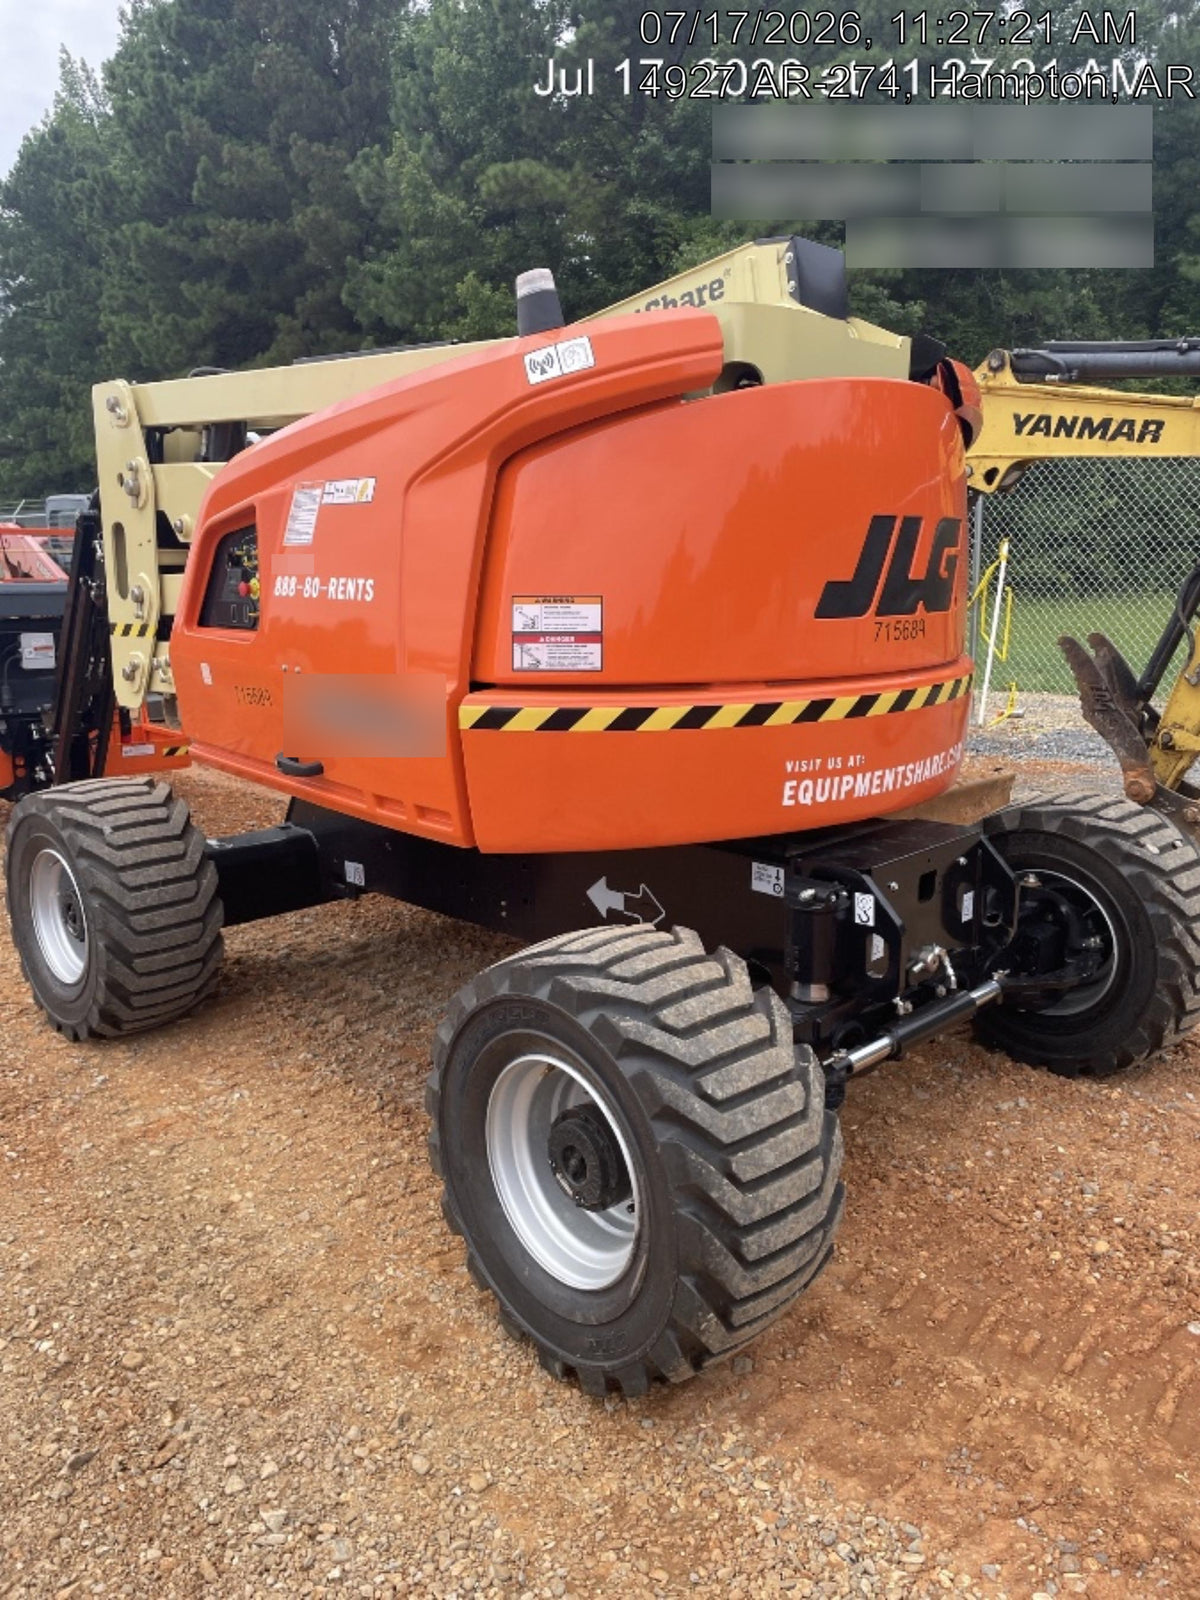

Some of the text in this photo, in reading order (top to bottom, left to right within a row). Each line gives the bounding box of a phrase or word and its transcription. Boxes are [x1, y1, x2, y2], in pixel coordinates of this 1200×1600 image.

[1013, 413, 1165, 443] YANMAR
[814, 515, 962, 619] JLG
[274, 576, 375, 602] 888-80-RENTS
[786, 754, 866, 773] VISIT US AT:
